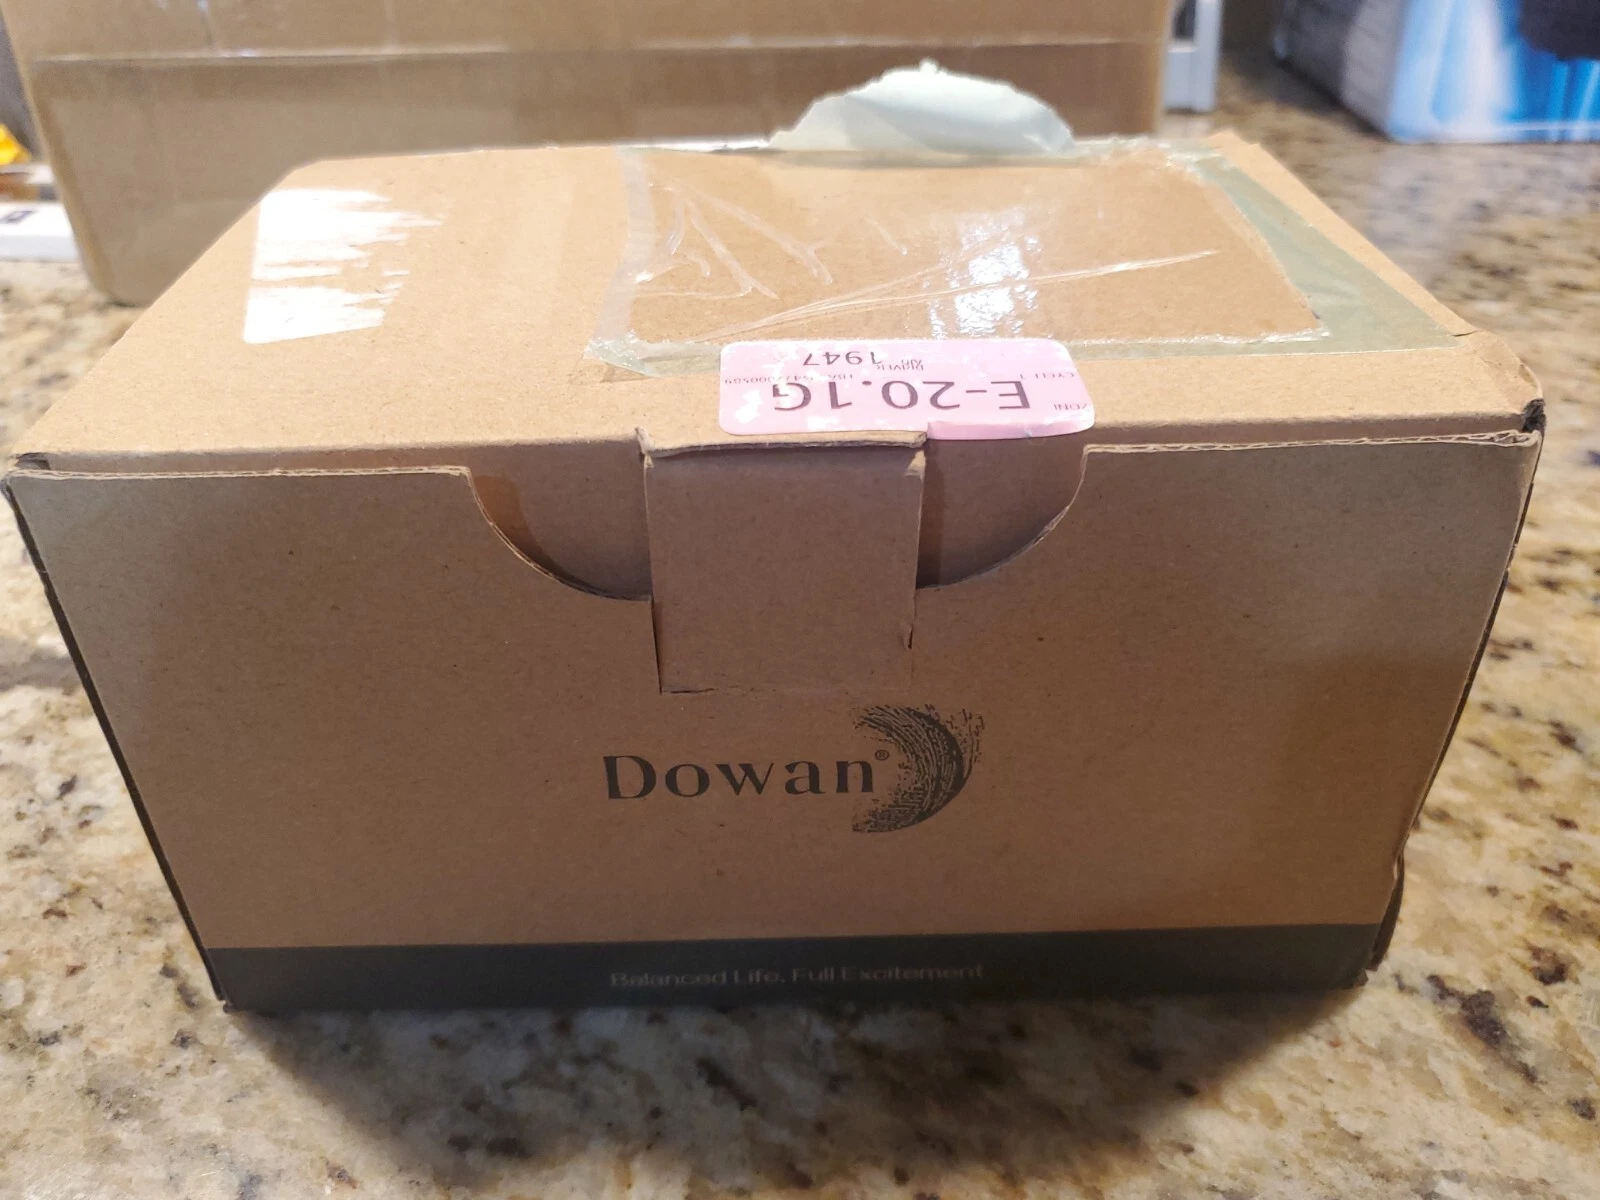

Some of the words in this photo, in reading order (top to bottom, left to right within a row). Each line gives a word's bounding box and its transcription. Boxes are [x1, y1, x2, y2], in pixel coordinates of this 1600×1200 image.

[803, 350, 883, 366] 1947
[772, 379, 1031, 412] E-20.1G
[610, 969, 727, 988] Balanced
[792, 966, 836, 984] Full
[841, 964, 984, 983] Excitement
